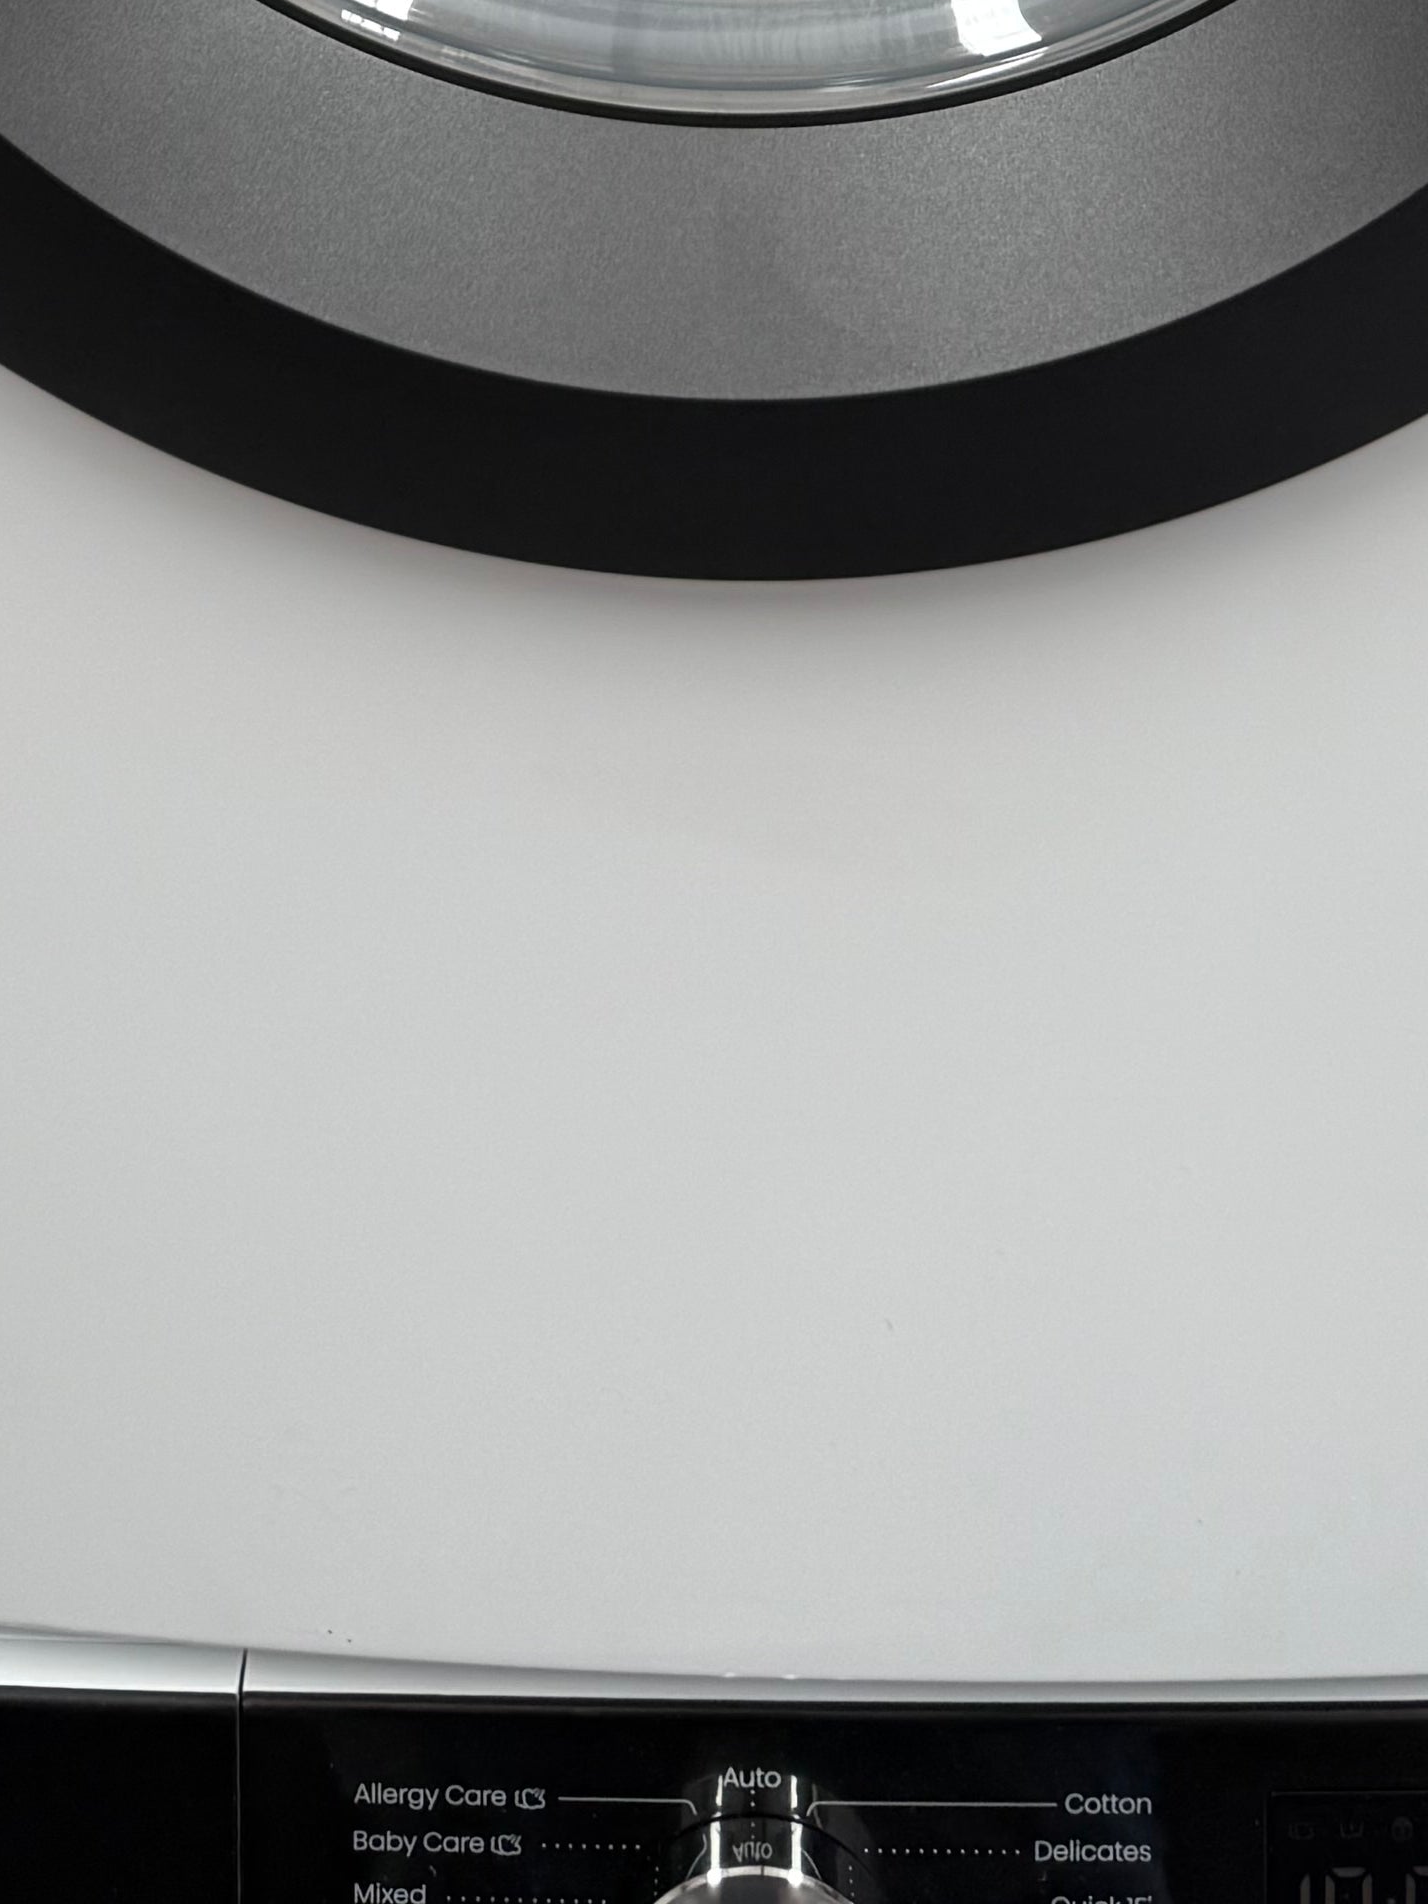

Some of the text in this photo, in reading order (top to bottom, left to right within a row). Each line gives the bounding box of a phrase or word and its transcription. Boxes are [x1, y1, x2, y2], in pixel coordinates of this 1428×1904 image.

[724, 1766, 782, 1788] Auto
[352, 1783, 507, 1812] Allergy Care
[1063, 1793, 1153, 1815] Cotton
[352, 1829, 485, 1858] Baby Care
[1033, 1838, 1152, 1863] Delicates
[352, 1883, 427, 1904] Mixed
